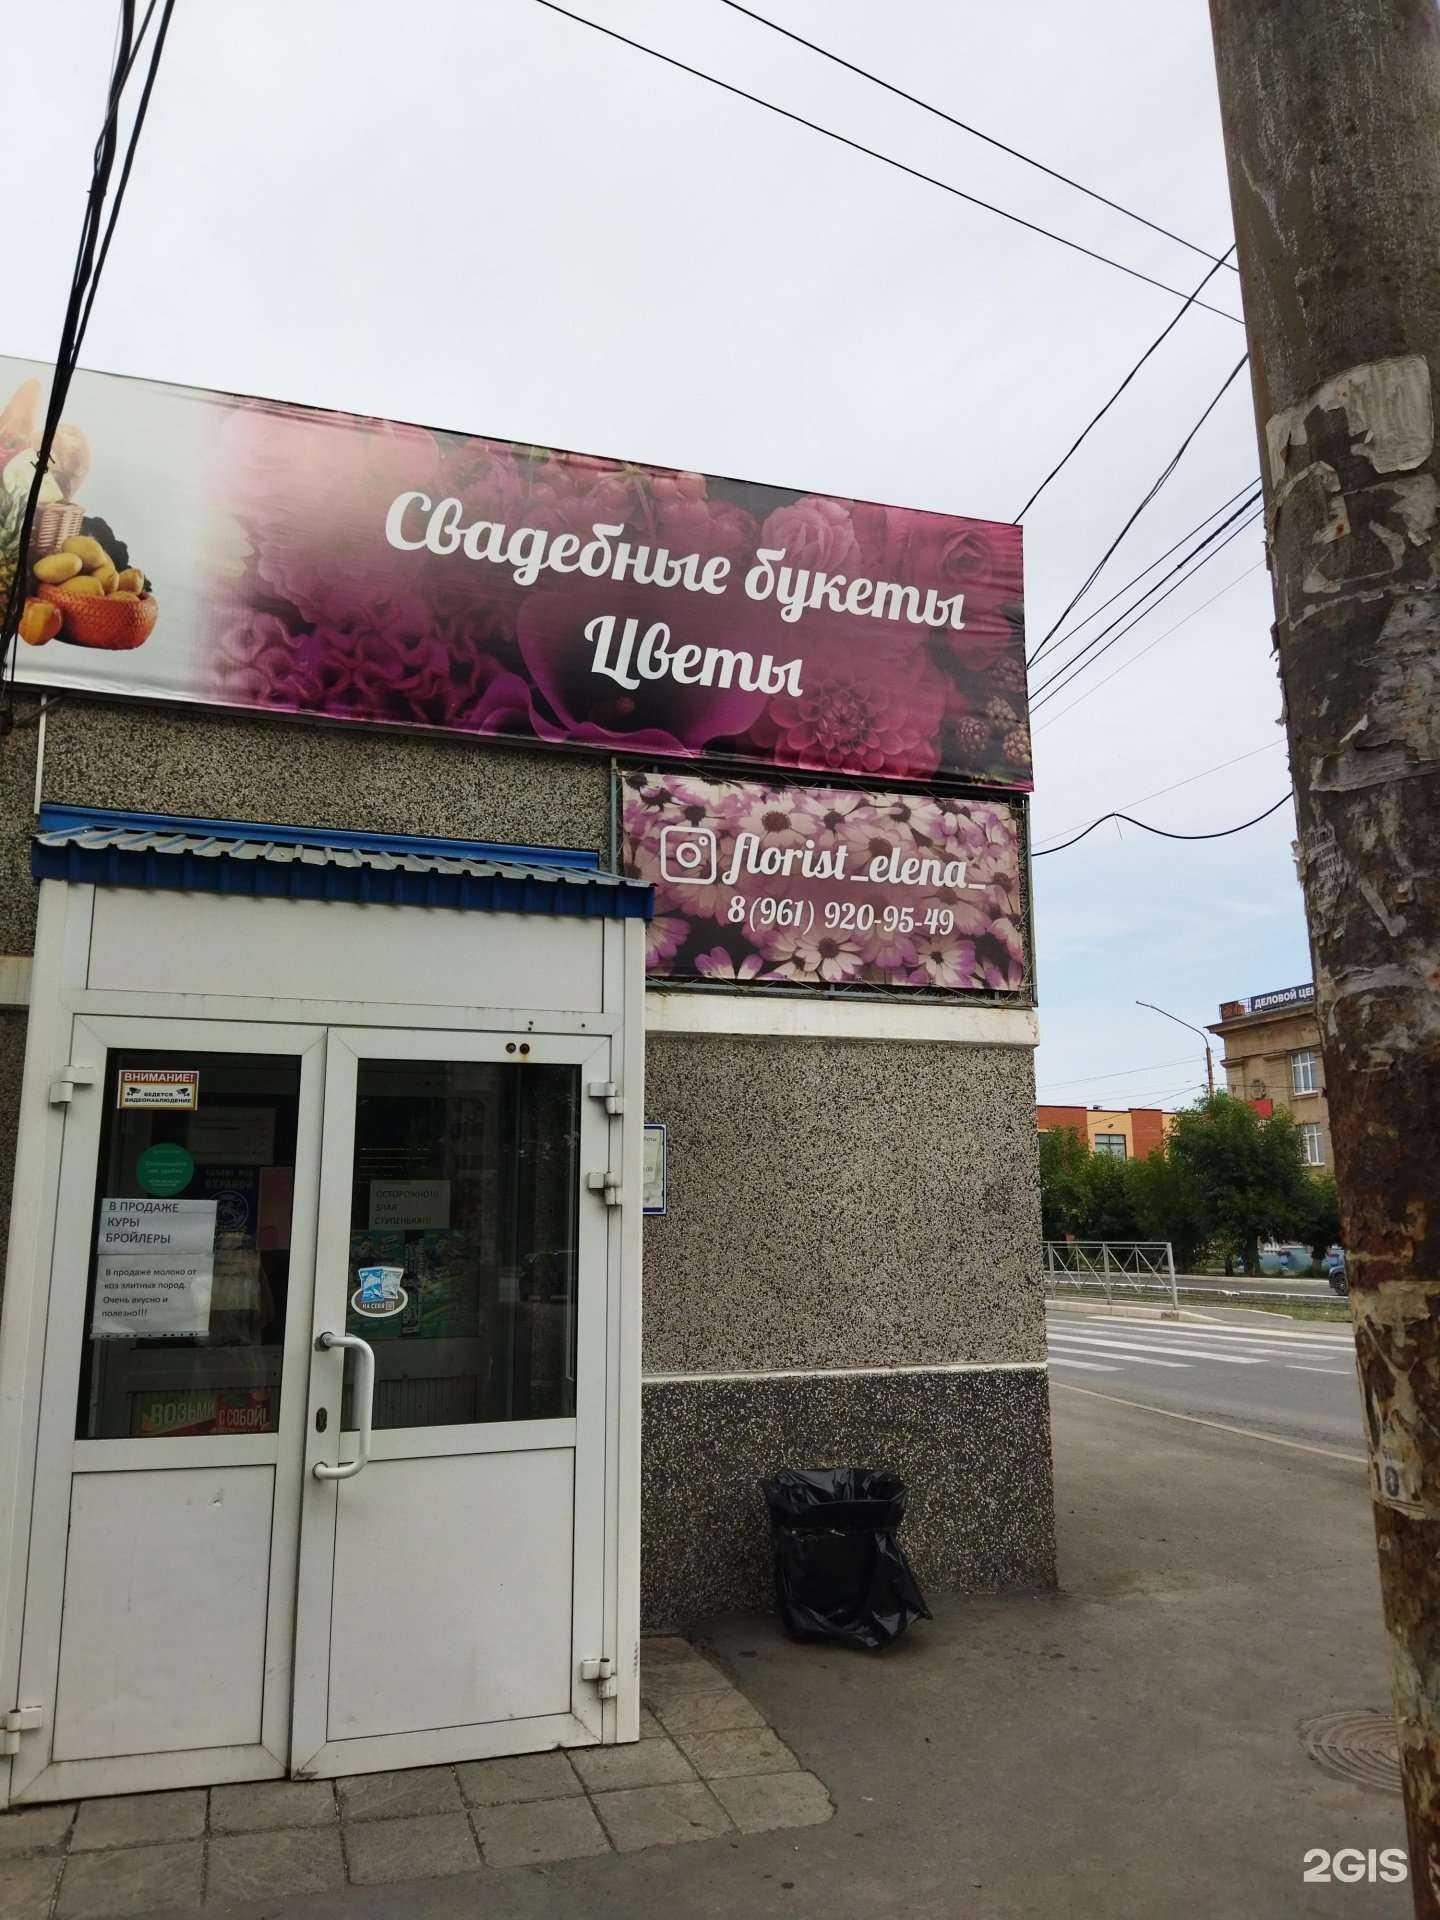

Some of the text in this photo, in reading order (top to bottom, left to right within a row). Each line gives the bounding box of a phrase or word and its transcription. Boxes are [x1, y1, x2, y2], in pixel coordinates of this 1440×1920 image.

[385, 490, 966, 631] Свадебные букеты
[583, 614, 803, 697] Цветы
[824, 900, 955, 936] 920-95-49
[1254, 988, 1297, 1009] ДЕЛОВОЙ
[124, 1072, 194, 1083] ВНИМАНИЕ!
[109, 1201, 180, 1214] В ПРОДАЖЕ
[107, 1216, 140, 1228] КУРЫ
[105, 1230, 171, 1244] БРОЙЛЕРЫ
[113, 1269, 151, 1278] продаже
[158, 1282, 187, 1291] пород.
[102, 1296, 130, 1304] Очень
[131, 1297, 161, 1305] вкусно
[151, 1400, 216, 1425] ВОЗЬМИ
